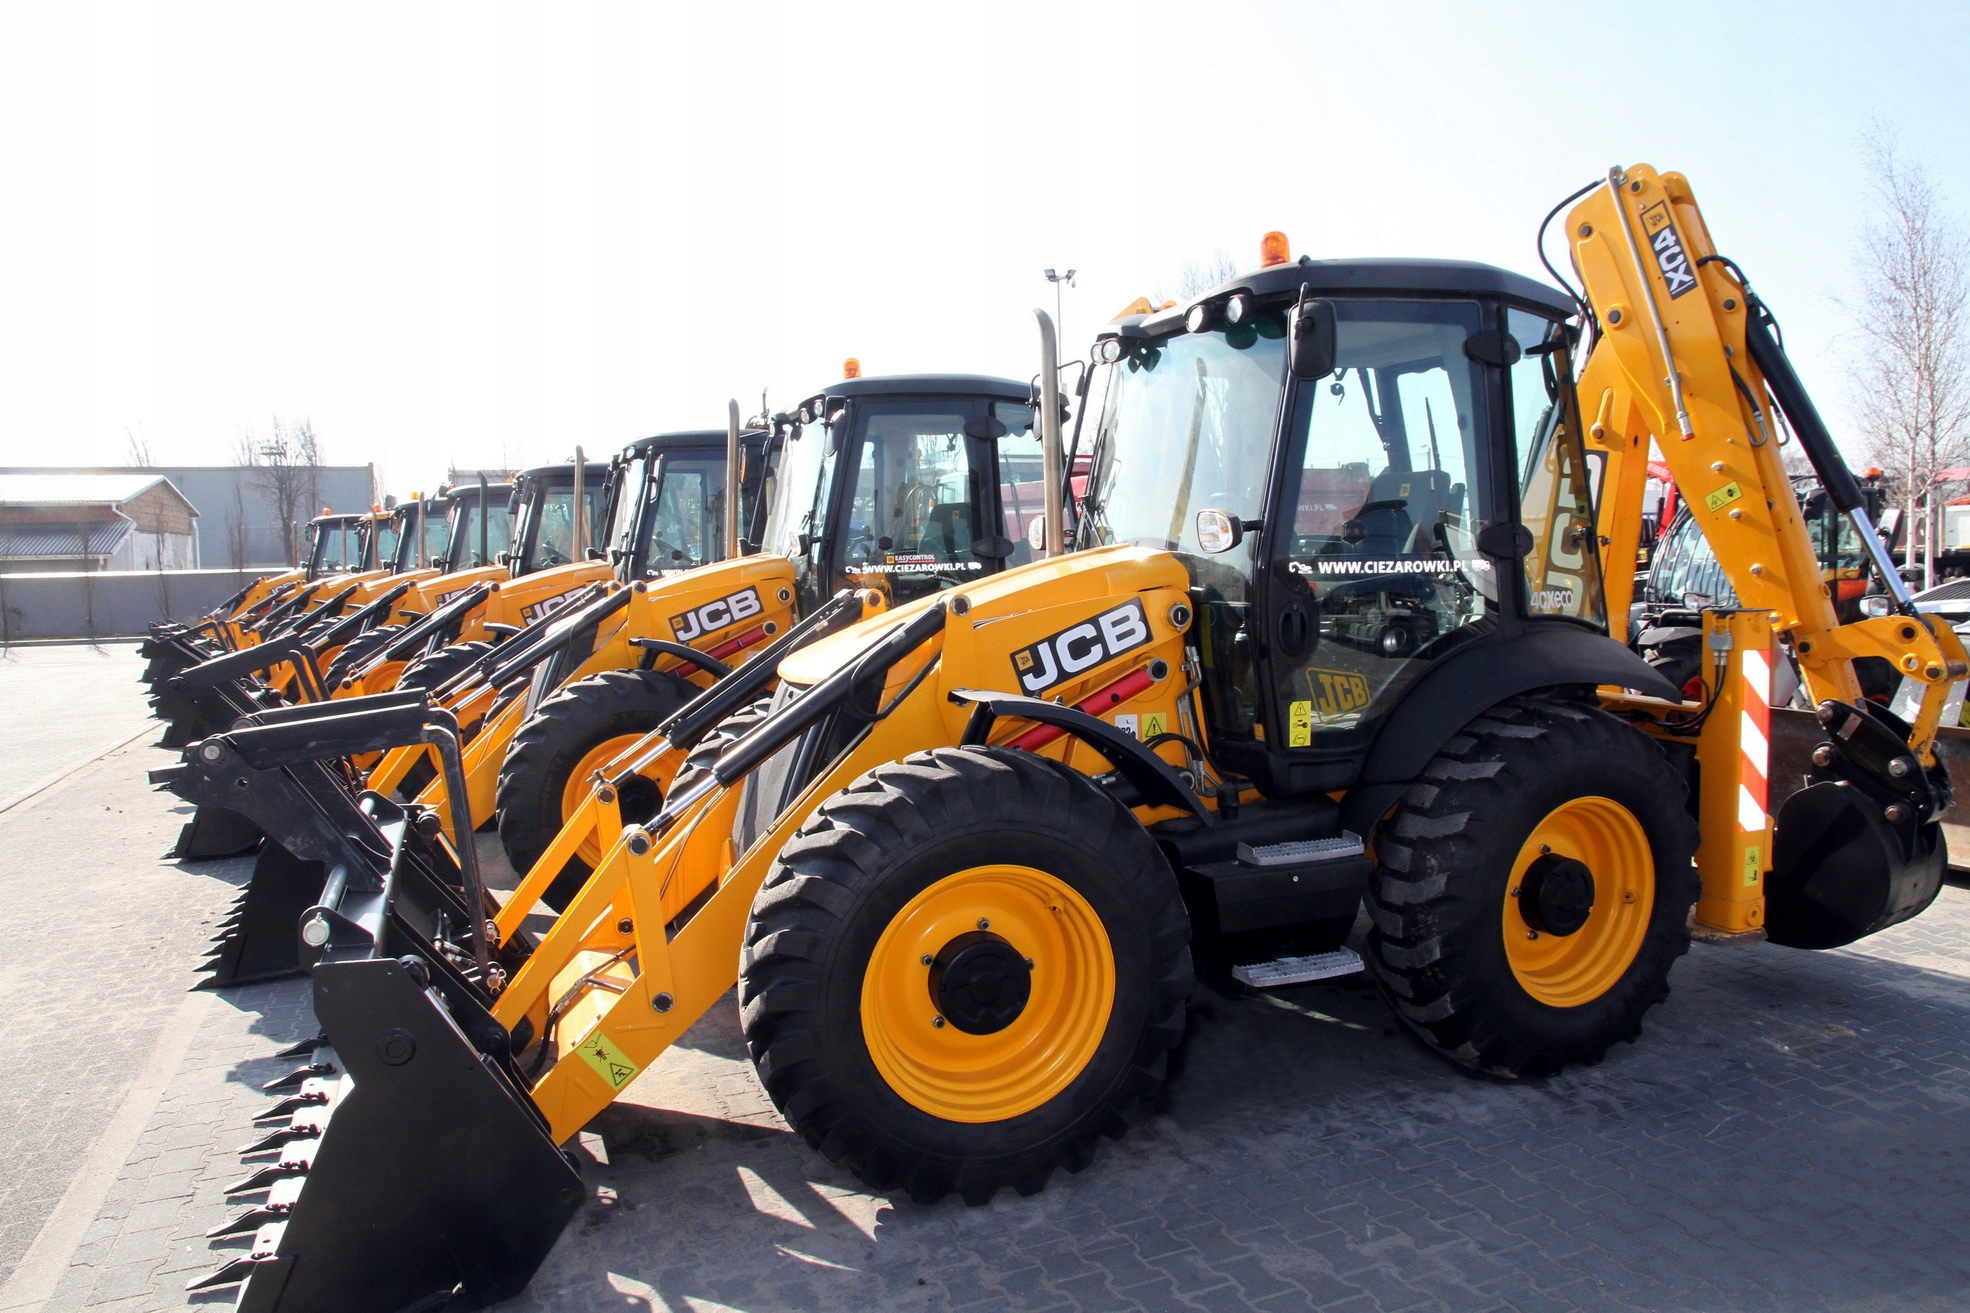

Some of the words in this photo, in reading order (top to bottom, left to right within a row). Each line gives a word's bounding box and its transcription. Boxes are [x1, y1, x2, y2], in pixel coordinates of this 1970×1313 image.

[1653, 227, 1694, 292] 4CX
[863, 562, 966, 573] WWW.CIEZAROWKI.PL
[1318, 560, 1469, 574] WWW.CIEZAROWKI.PL
[676, 589, 761, 641] JCB
[1530, 590, 1573, 609] 4CXeco
[1022, 604, 1147, 691] JCB
[1318, 673, 1367, 717] JCB
